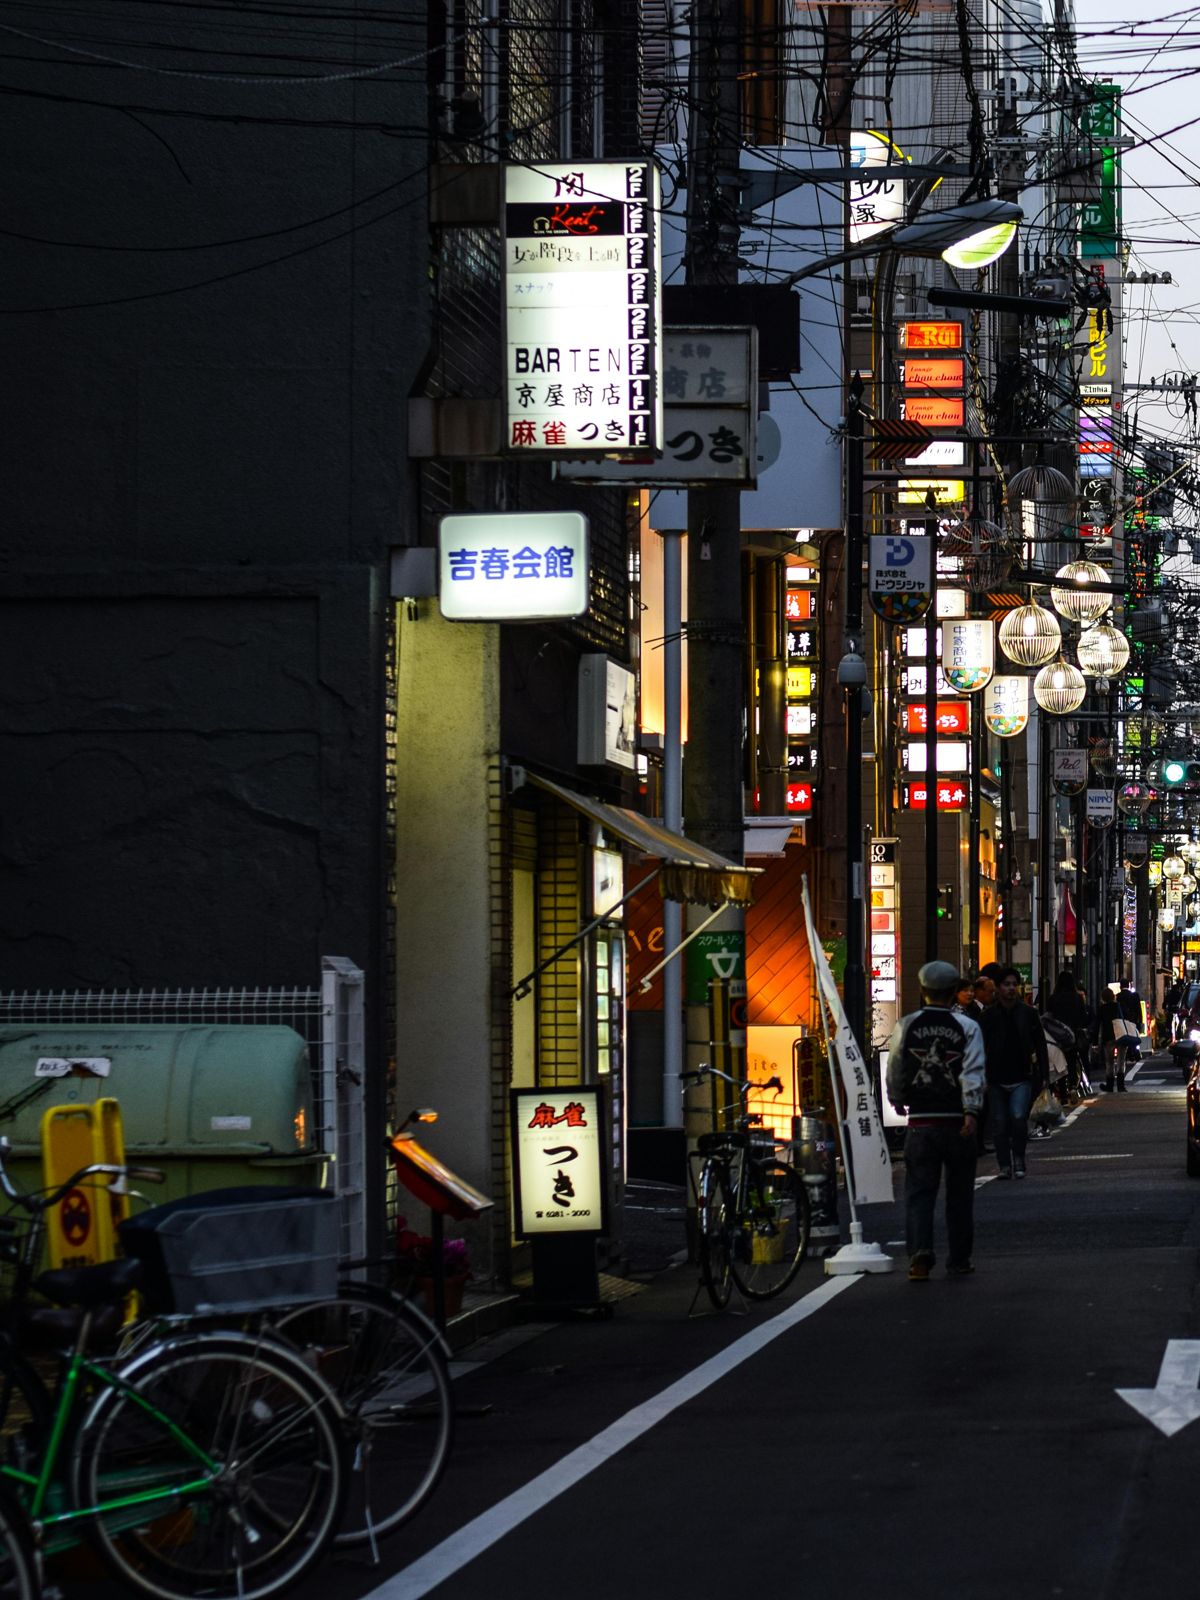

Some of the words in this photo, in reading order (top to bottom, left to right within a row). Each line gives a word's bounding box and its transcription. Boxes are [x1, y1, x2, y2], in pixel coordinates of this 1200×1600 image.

[516, 348, 561, 373] BAR
[515, 382, 622, 409] 京屋商店
[511, 419, 568, 446] 麻雀
[577, 419, 626, 441] つき
[666, 425, 745, 464] つき
[448, 545, 575, 580] 吉春会館
[875, 571, 907, 579] 株式会社
[875, 579, 926, 591] ドウシシャ
[911, 1025, 963, 1044] VANSON
[528, 1101, 588, 1129] 麻雀
[543, 1145, 580, 1208] つき
